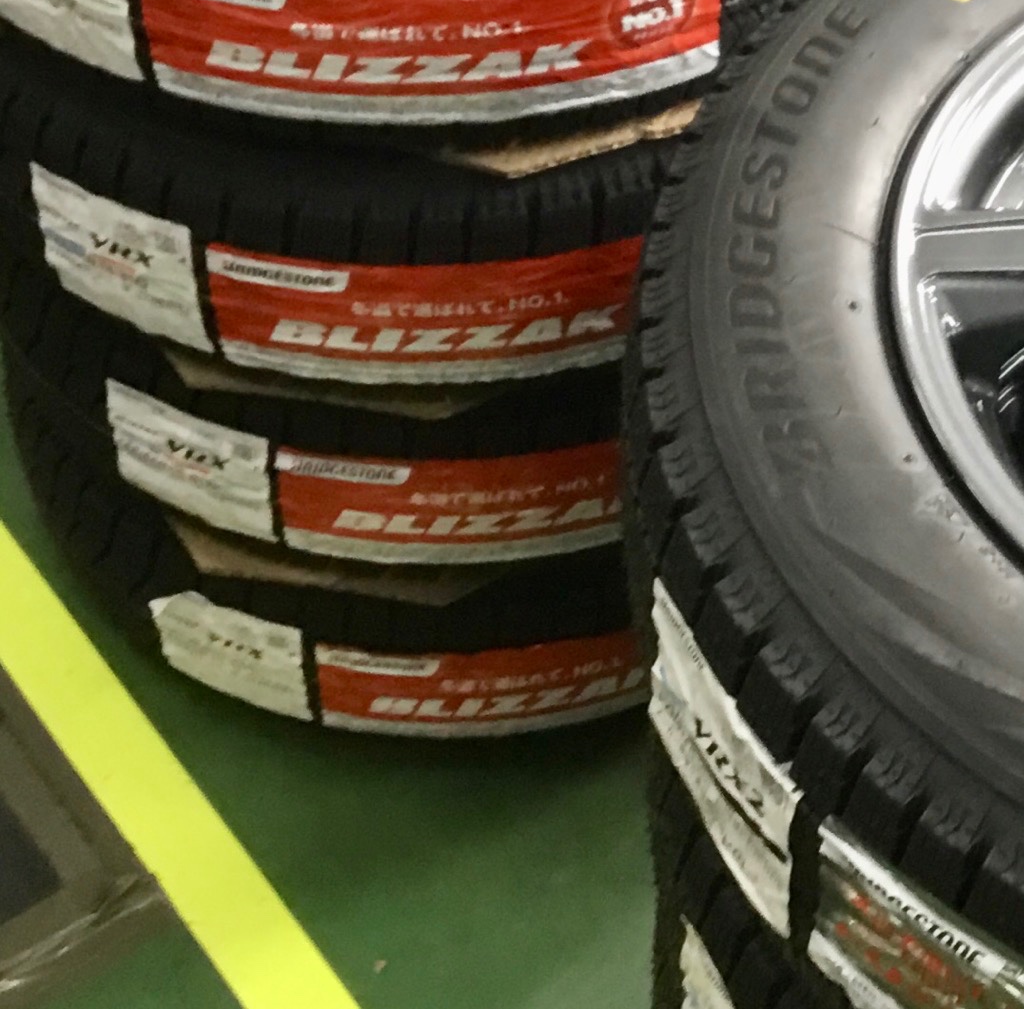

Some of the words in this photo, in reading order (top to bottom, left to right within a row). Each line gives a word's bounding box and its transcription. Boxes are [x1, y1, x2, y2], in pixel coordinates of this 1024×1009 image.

[205, 39, 592, 83] BLIZZAK
[728, 4, 868, 466] BRIDGESTONE
[271, 303, 624, 354] BLIZZAK
